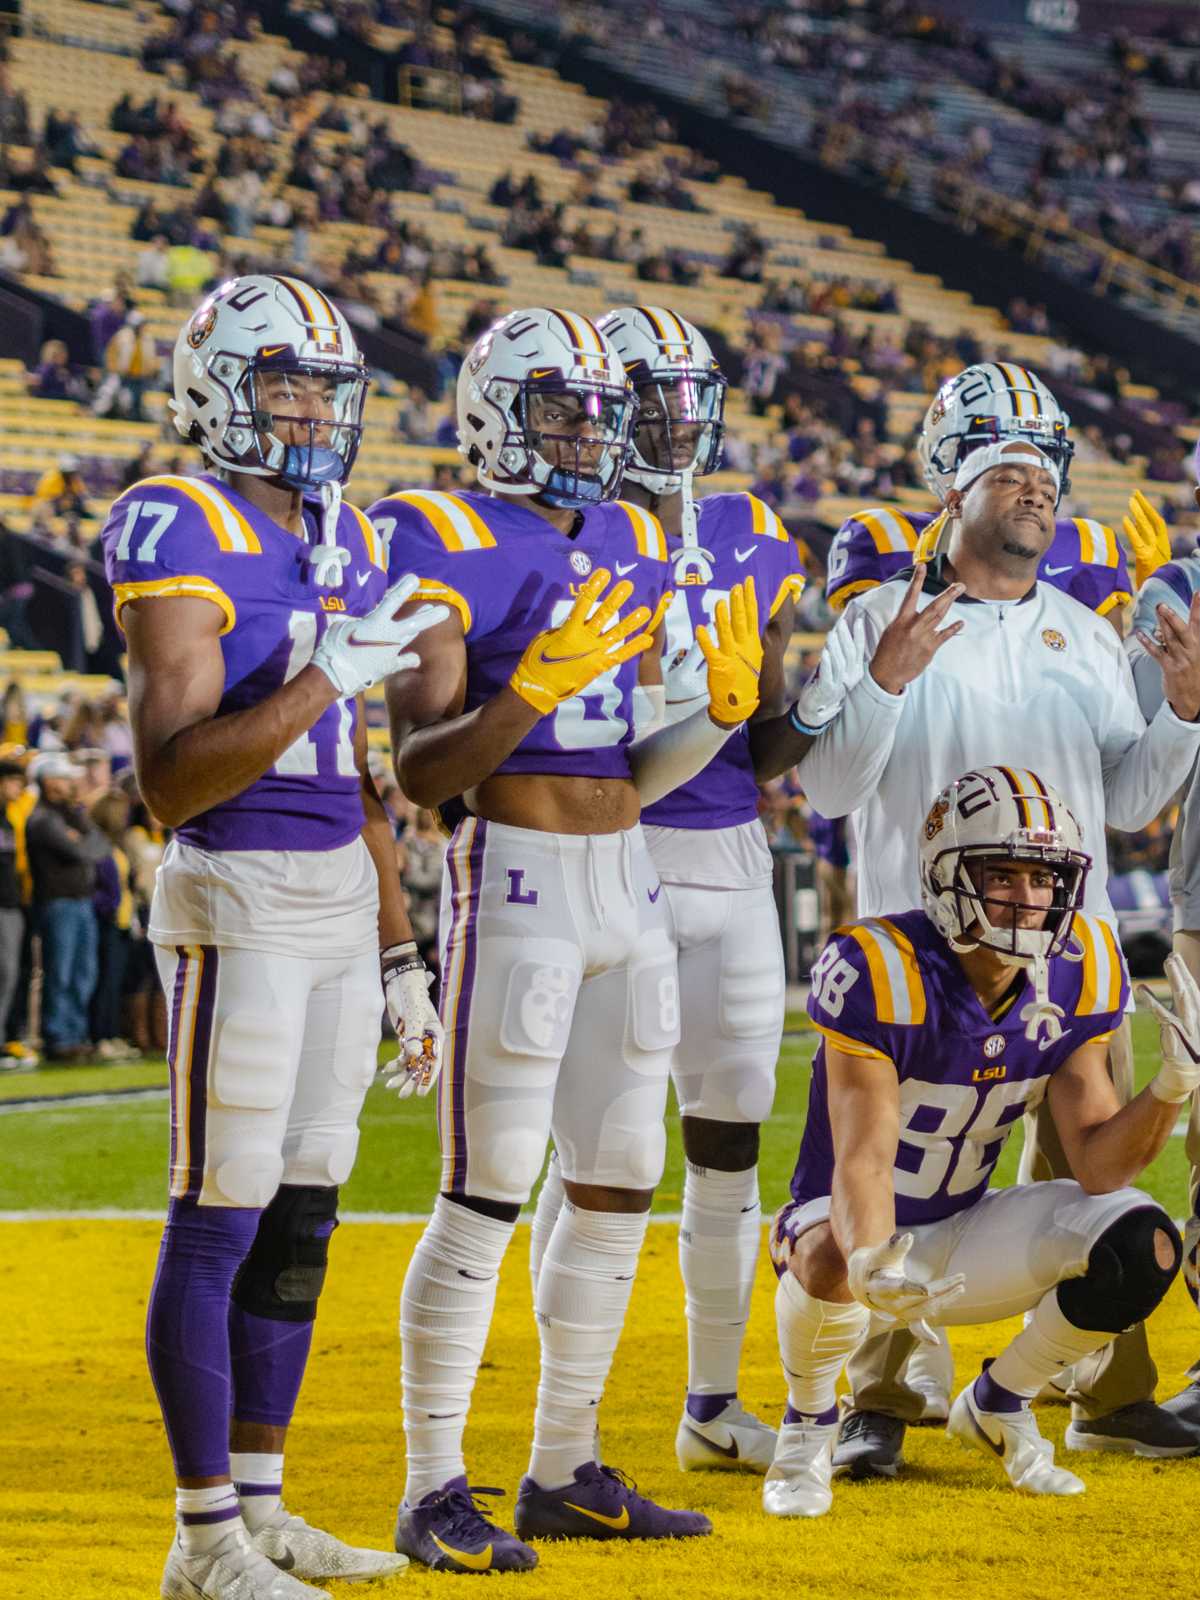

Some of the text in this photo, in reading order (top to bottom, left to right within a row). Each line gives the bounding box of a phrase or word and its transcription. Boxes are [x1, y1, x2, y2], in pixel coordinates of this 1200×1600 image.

[1018, 419, 1041, 430] LSU
[115, 500, 179, 563] 17
[319, 595, 346, 612] LSU
[505, 869, 539, 906] L
[810, 941, 860, 1018] 88
[972, 1065, 1006, 1082] LSU
